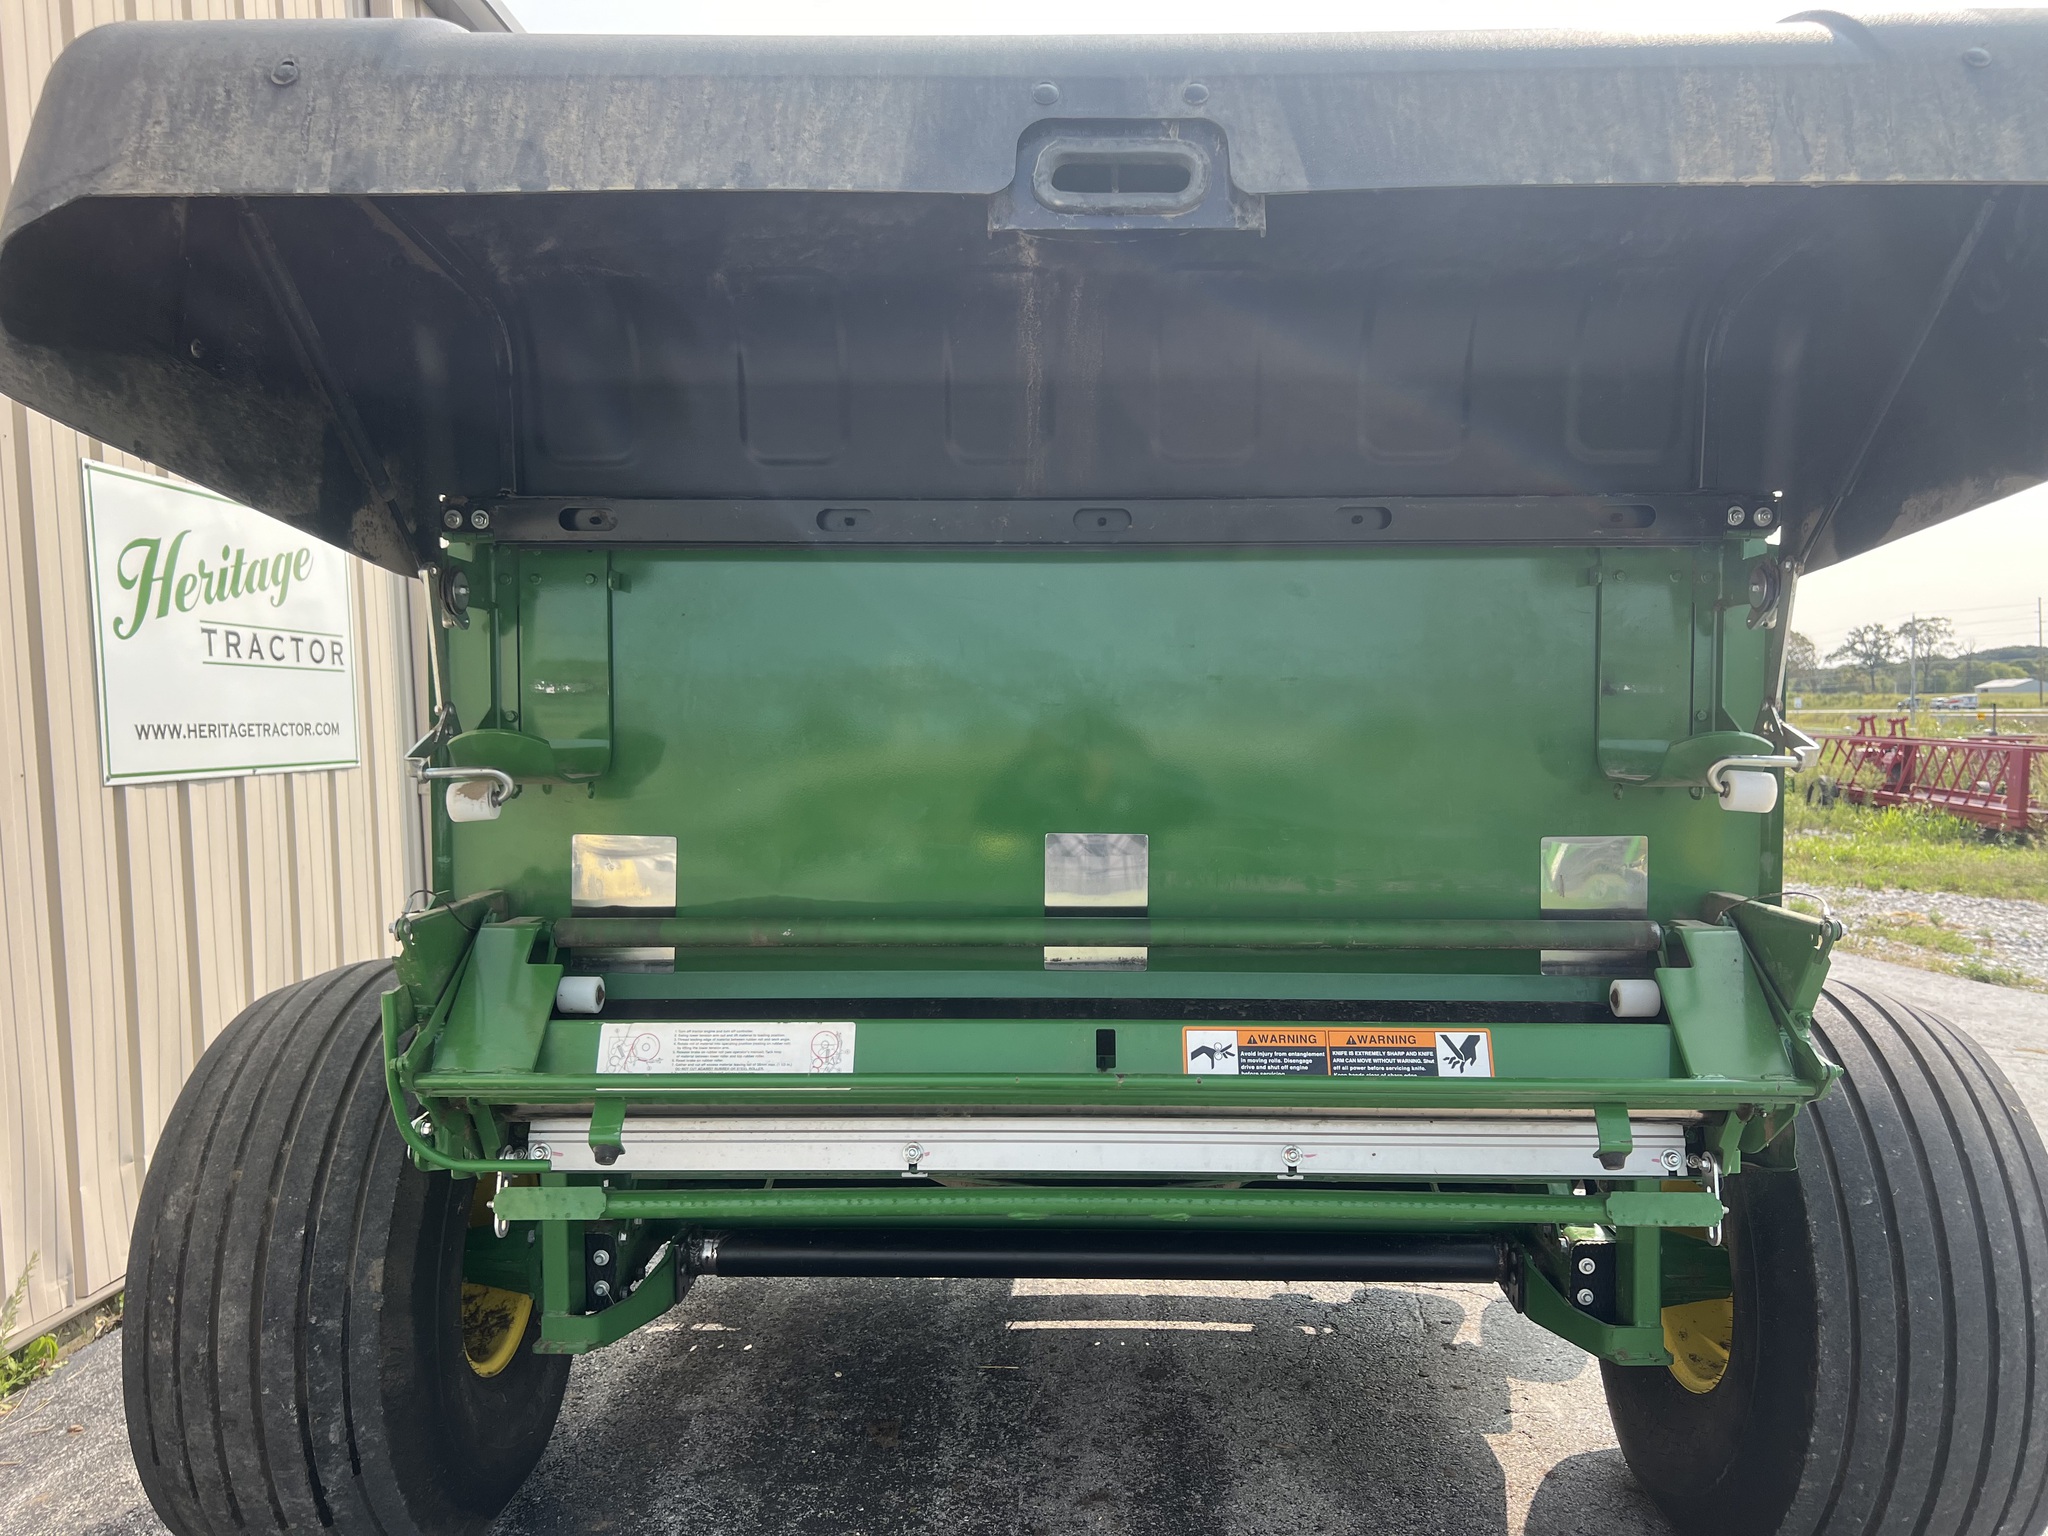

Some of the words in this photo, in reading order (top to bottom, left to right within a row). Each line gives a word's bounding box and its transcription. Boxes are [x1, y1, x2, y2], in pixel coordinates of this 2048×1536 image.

[113, 529, 314, 640] Heritage
[200, 627, 345, 666] TRACTOR
[134, 722, 340, 740] WWW.HERITAGETRACTOR.COM
[1258, 1035, 1317, 1044] WARNING
[1357, 1035, 1417, 1044] WARNING
